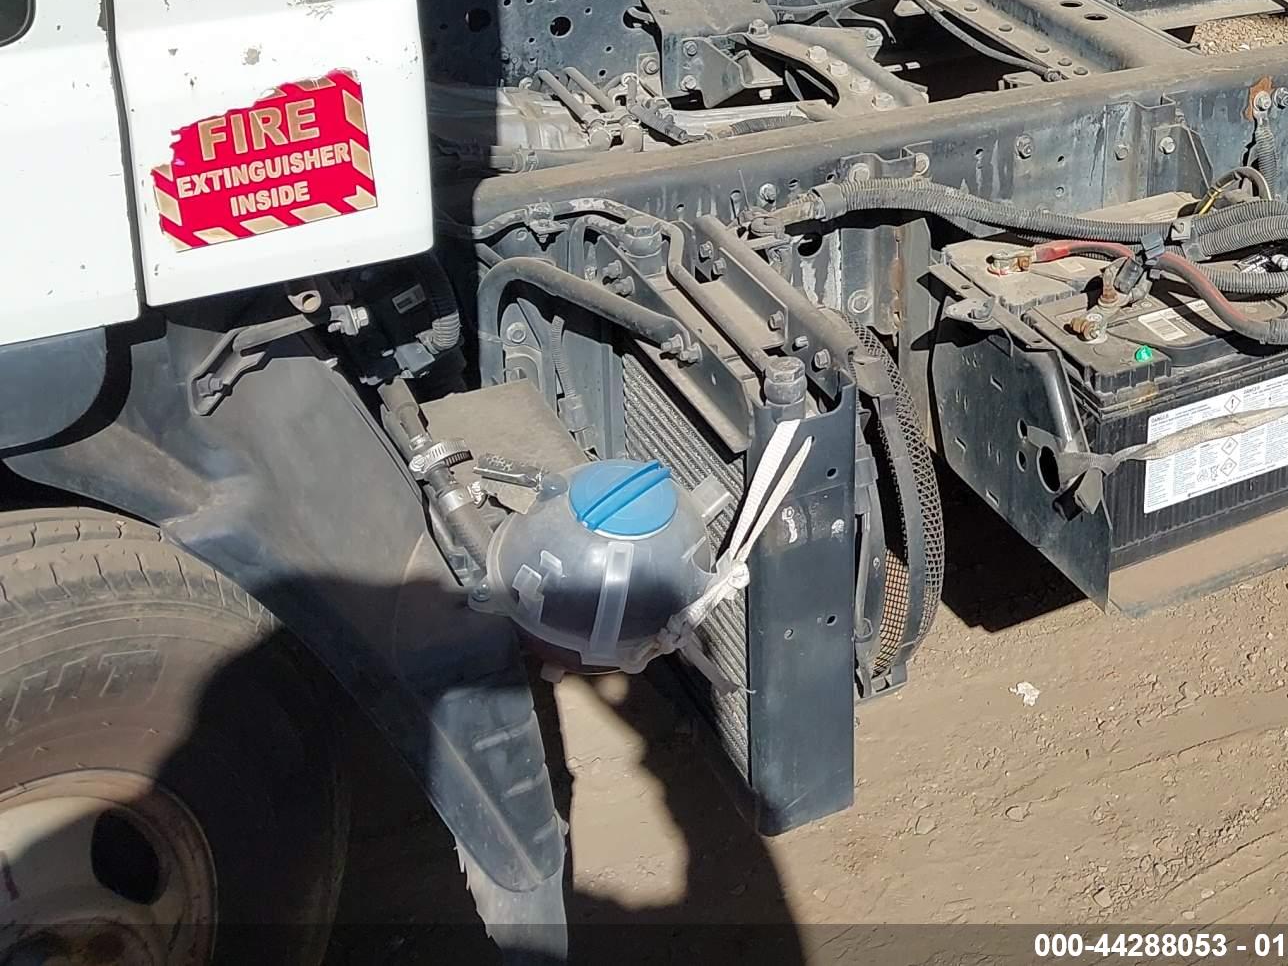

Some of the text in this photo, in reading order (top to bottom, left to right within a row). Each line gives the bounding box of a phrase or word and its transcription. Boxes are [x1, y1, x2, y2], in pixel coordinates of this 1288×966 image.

[197, 99, 320, 162] FIRE
[176, 142, 352, 199] EXTINGUISHER
[230, 181, 310, 217] INSIDE
